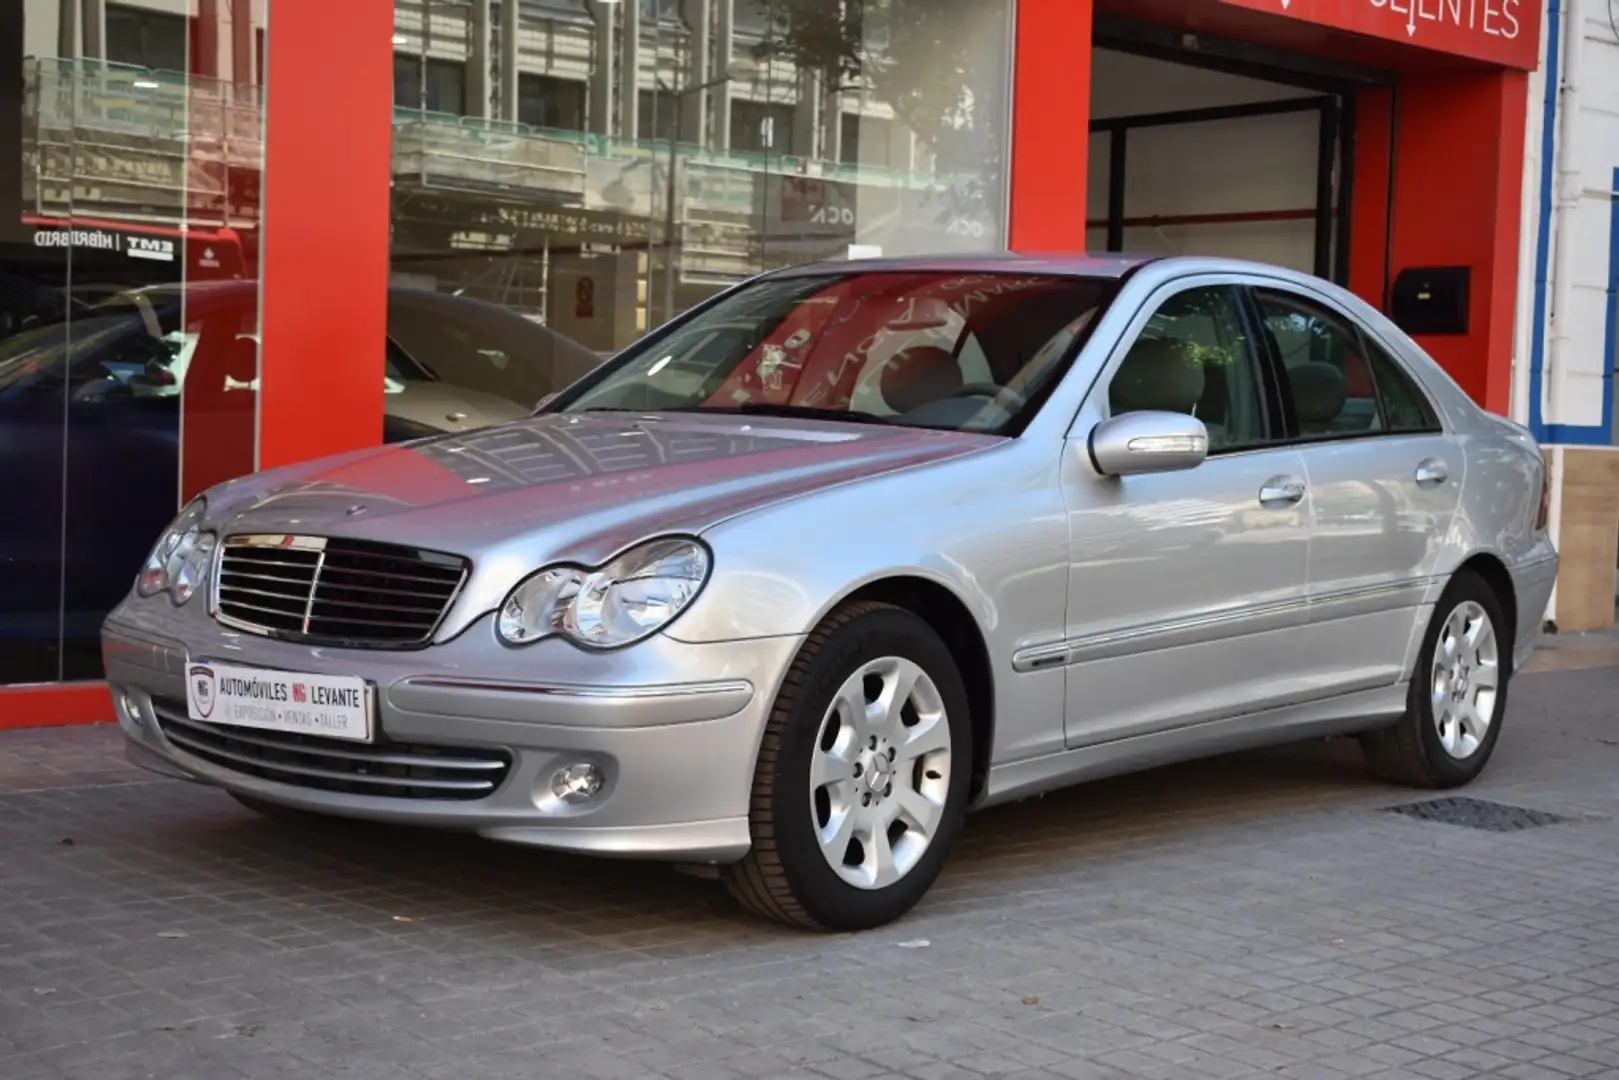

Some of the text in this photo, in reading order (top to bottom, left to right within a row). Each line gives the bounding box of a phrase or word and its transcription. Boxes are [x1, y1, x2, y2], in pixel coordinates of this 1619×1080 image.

[220, 676, 288, 702] AUTOMÓVILES
[311, 686, 360, 708] LEVANTE
[283, 709, 313, 727] VENTAS
[320, 713, 348, 730] TALLER
